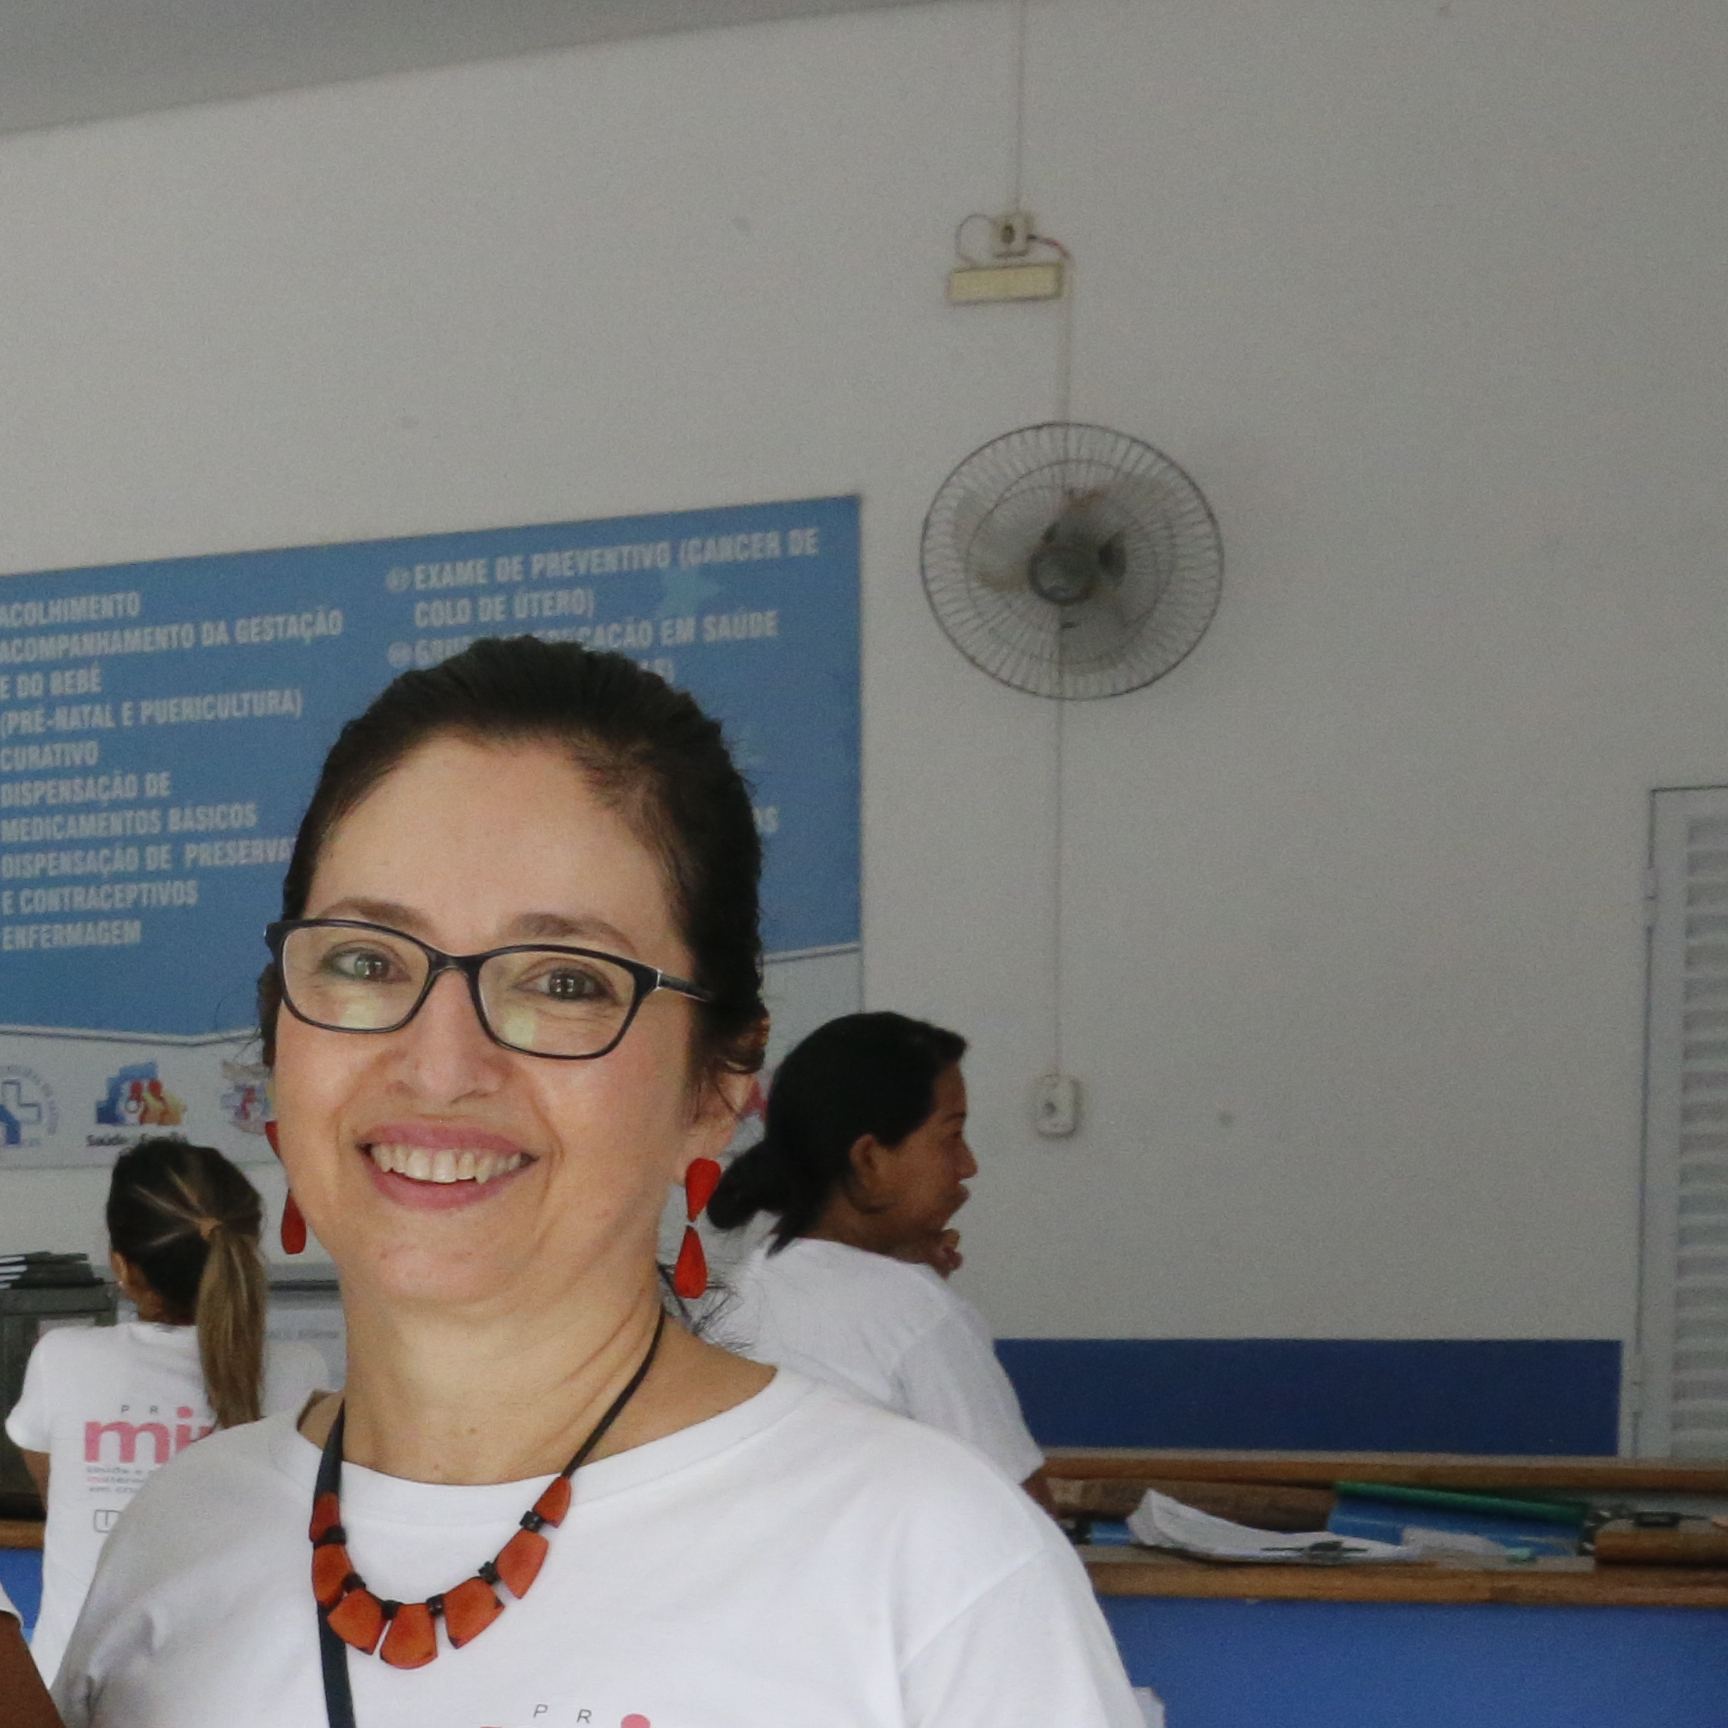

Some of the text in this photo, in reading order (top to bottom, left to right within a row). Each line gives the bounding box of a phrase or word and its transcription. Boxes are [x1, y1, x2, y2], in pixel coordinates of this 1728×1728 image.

[413, 558, 489, 591] EXAME
[495, 555, 524, 582] DE
[530, 541, 671, 580] PREVENTIVO
[787, 528, 820, 555] DE
[200, 619, 230, 647] DA
[234, 605, 344, 646] GESTAÇÃO
[414, 597, 472, 628] COLO
[478, 594, 508, 623] DE
[660, 617, 697, 646] EM
[702, 605, 779, 642] SAÚDE
[15, 671, 44, 699] DO
[121, 701, 134, 727] E
[0, 740, 99, 772] CURATIVO
[0, 769, 172, 808] DISPENSAÇÃO DE
[0, 808, 163, 843] MEDICAMENTOS
[1, 837, 296, 880] DISPENSAÇÃO DE PRESERVA
[1, 879, 199, 916] E CONTRACEPTIVOS
[1, 919, 142, 950] ENFERMAGEM
[84, 1405, 214, 1464] mi
